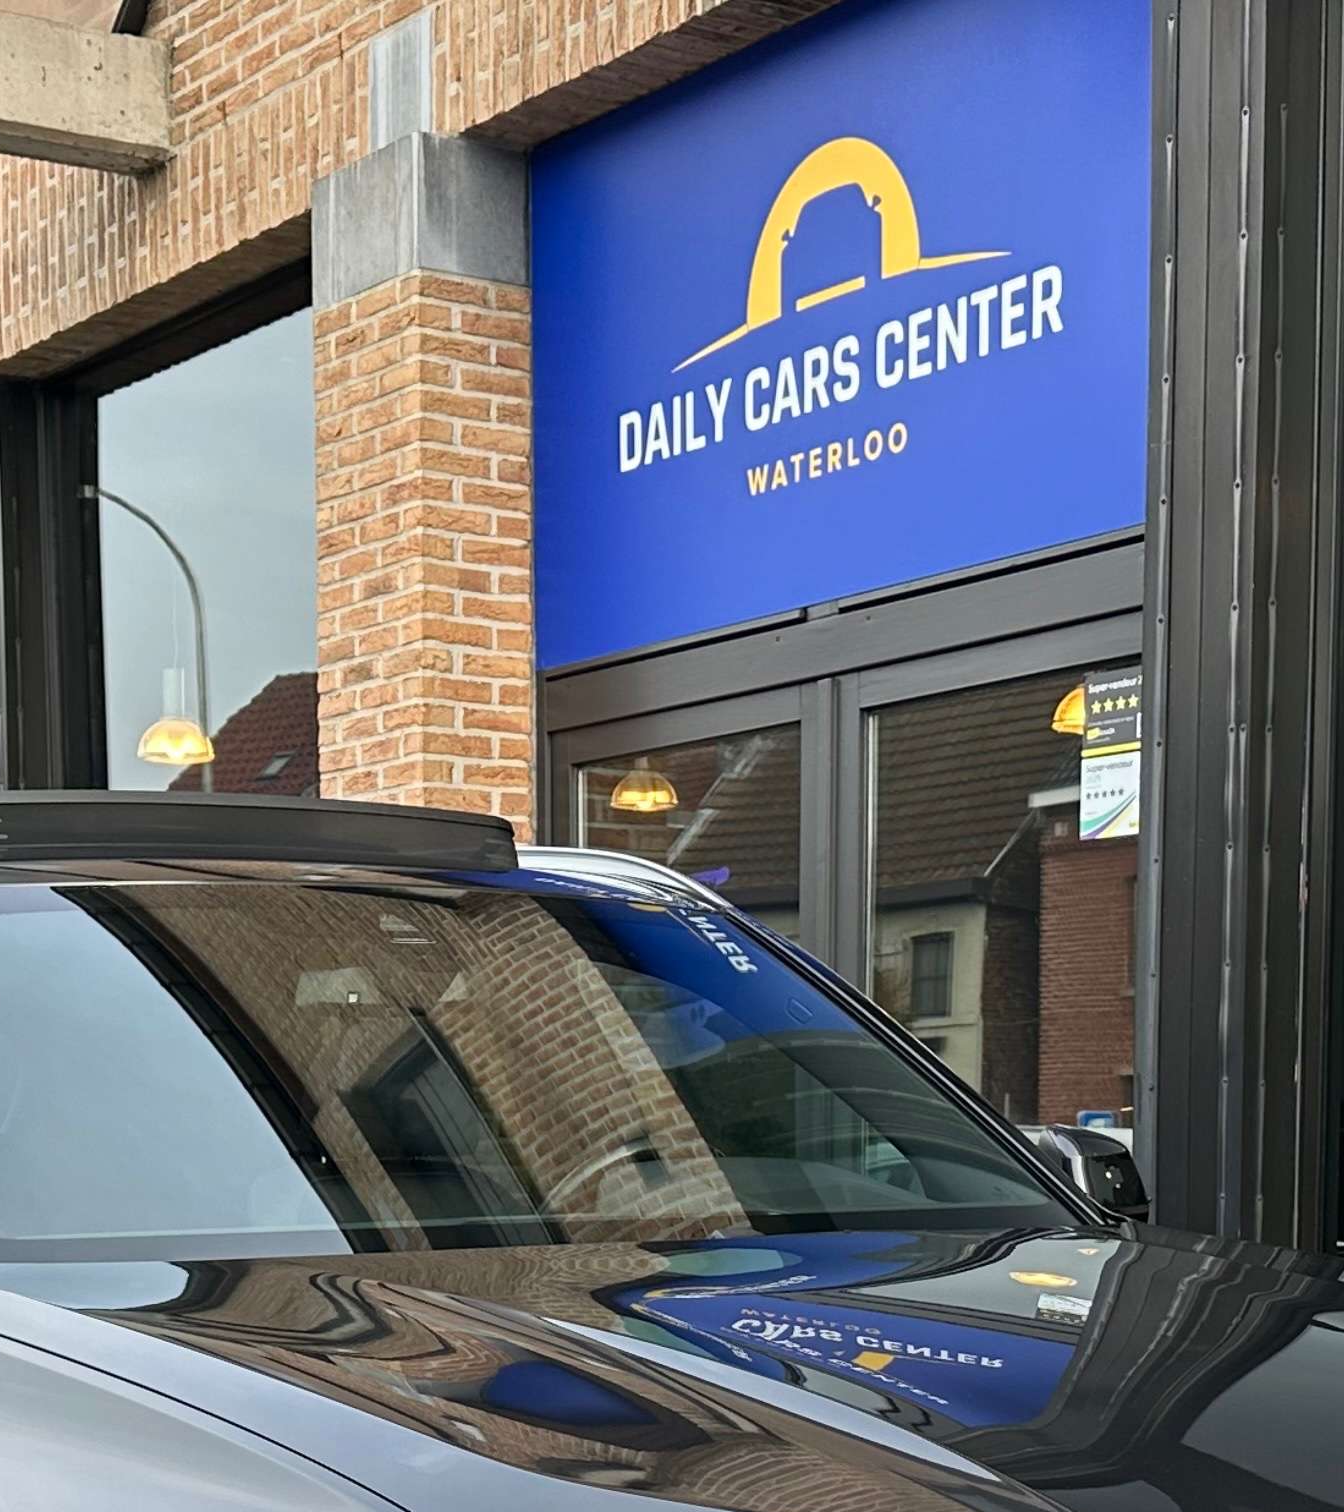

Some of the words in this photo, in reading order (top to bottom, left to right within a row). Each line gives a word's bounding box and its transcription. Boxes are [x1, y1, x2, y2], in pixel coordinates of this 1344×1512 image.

[619, 378, 732, 473] DAILY
[745, 334, 860, 432] CARS
[875, 264, 1065, 389] CENTER
[747, 422, 908, 496] WATERLOO
